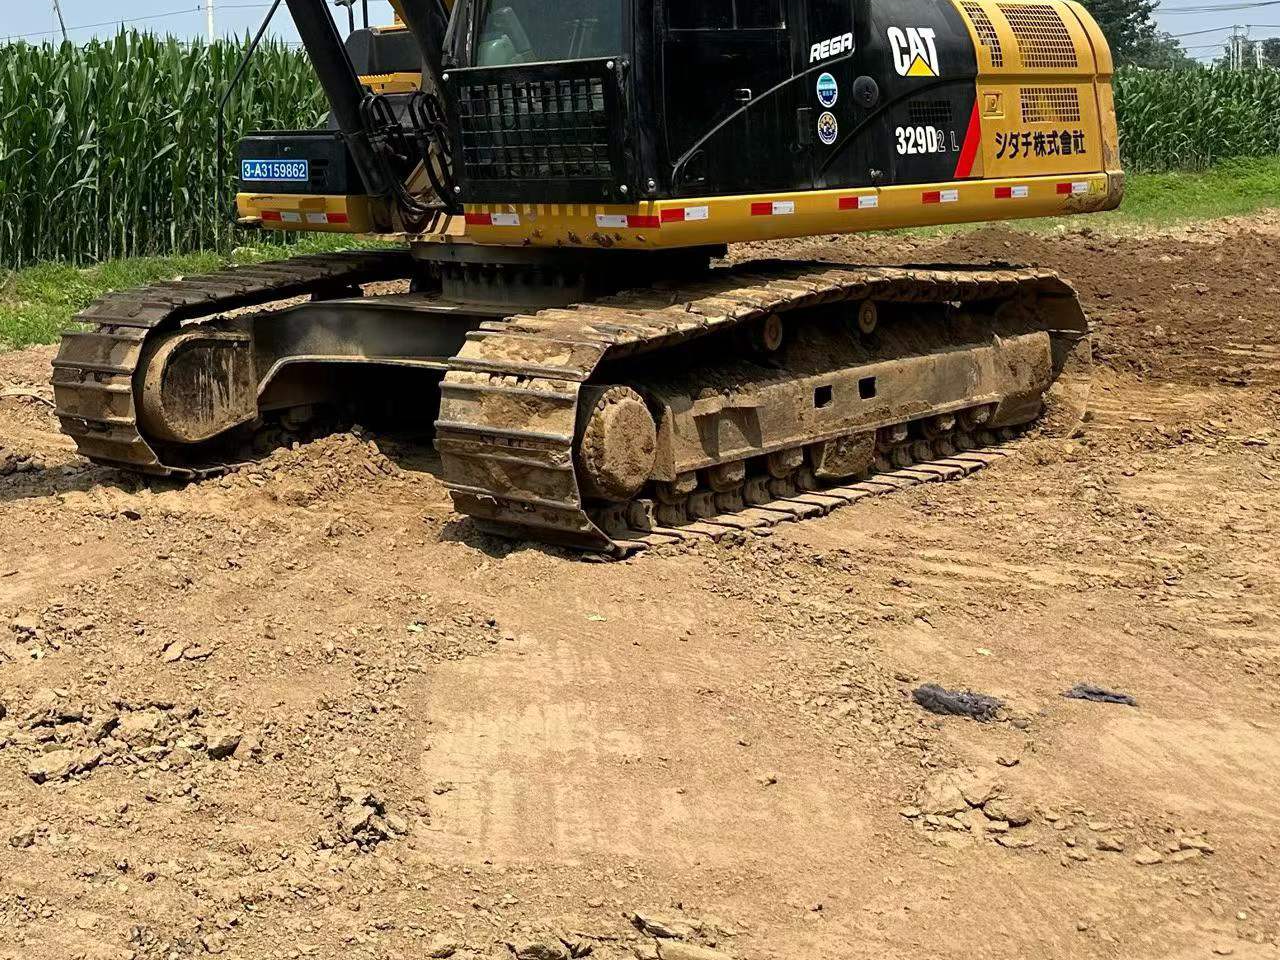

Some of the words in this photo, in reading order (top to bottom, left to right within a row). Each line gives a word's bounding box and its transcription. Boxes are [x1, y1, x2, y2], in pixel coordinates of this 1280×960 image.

[809, 32, 853, 63] REGA
[887, 26, 940, 77] CAT
[995, 129, 1087, 160] シダチ株式會社
[244, 163, 306, 178] 3-A3159862
